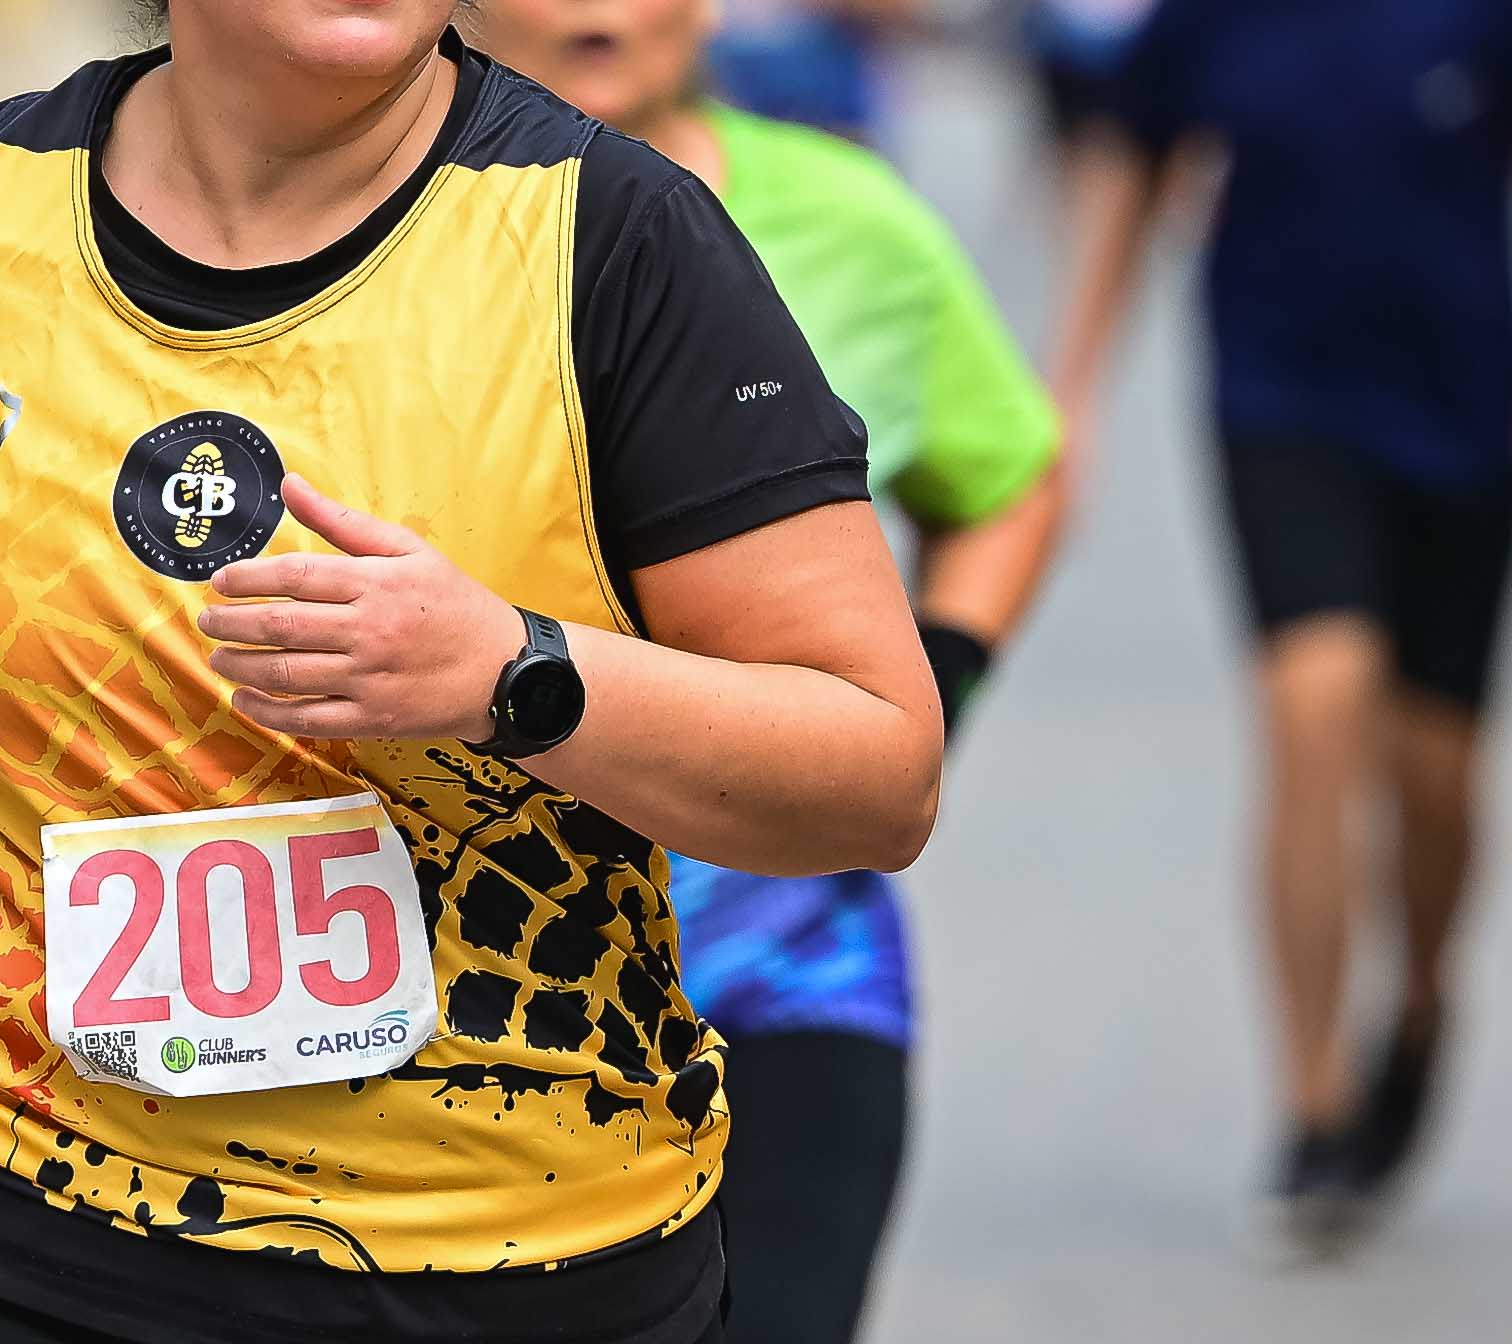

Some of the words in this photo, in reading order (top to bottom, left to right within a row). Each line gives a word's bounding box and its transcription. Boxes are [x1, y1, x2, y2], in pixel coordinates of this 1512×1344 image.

[735, 383, 757, 402] UV
[759, 381, 783, 397] 50+
[148, 419, 223, 444] TRAINING
[239, 427, 267, 455] CLUB
[161, 472, 237, 517] CB
[126, 514, 175, 567] RUNNING
[186, 560, 215, 570] AND
[225, 527, 264, 563] TRAIL
[69, 827, 401, 1028] 205
[198, 1037, 234, 1052] CLUB
[296, 1024, 408, 1057] CARUSO
[359, 1044, 409, 1060] SEGUROS
[198, 1048, 268, 1067] RUNNER'S
